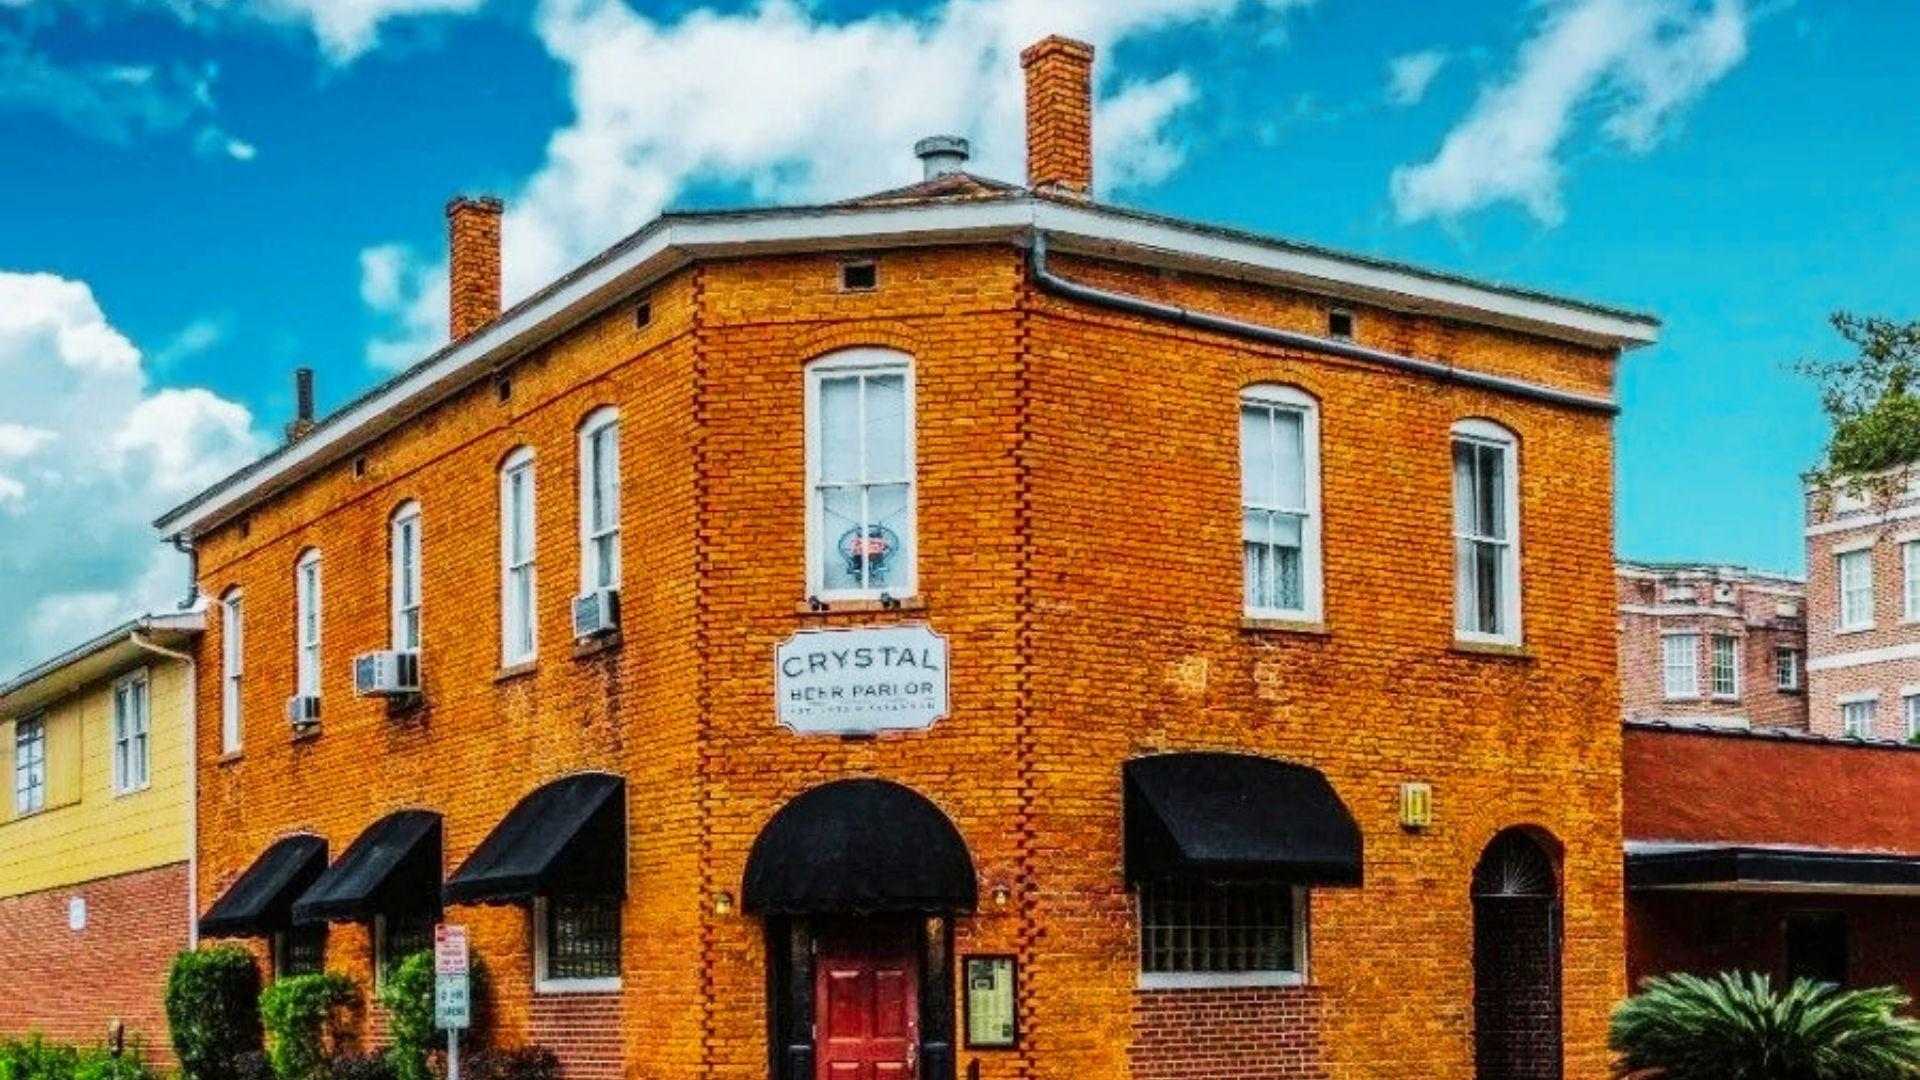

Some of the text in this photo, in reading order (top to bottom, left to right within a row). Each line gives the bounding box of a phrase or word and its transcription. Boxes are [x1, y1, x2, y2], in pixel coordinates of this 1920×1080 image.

[782, 647, 939, 677] CRYSTAL
[791, 682, 934, 701] BEER PARLOR
